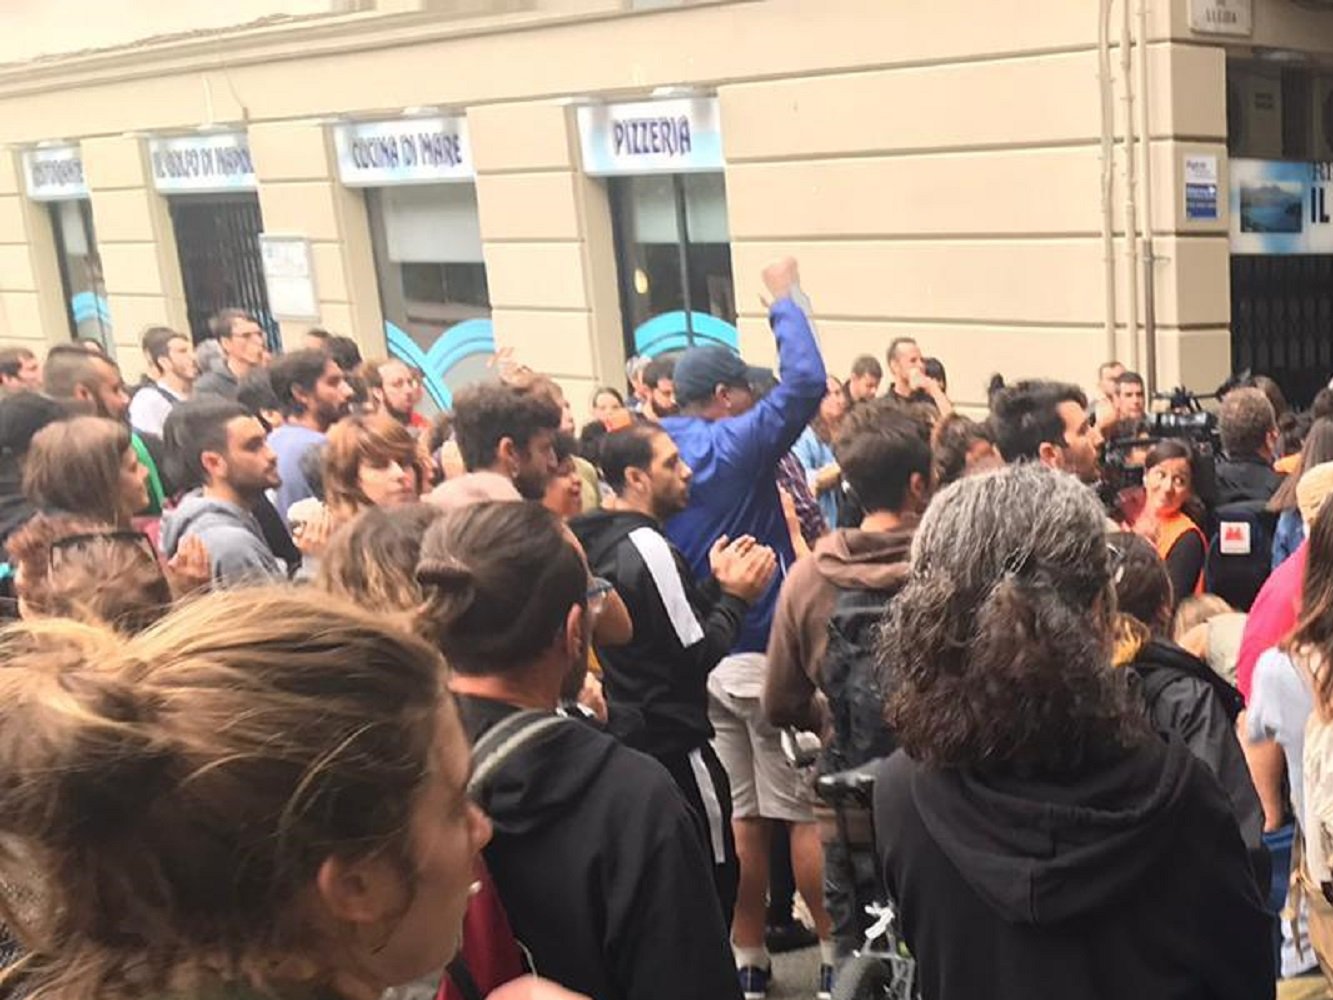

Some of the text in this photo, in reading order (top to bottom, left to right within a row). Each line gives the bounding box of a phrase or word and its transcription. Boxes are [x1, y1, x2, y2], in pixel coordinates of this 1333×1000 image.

[352, 132, 463, 169] CUCINA DI MARE
[612, 115, 692, 157] PIZZERIA
[1311, 187, 1330, 224] IL
